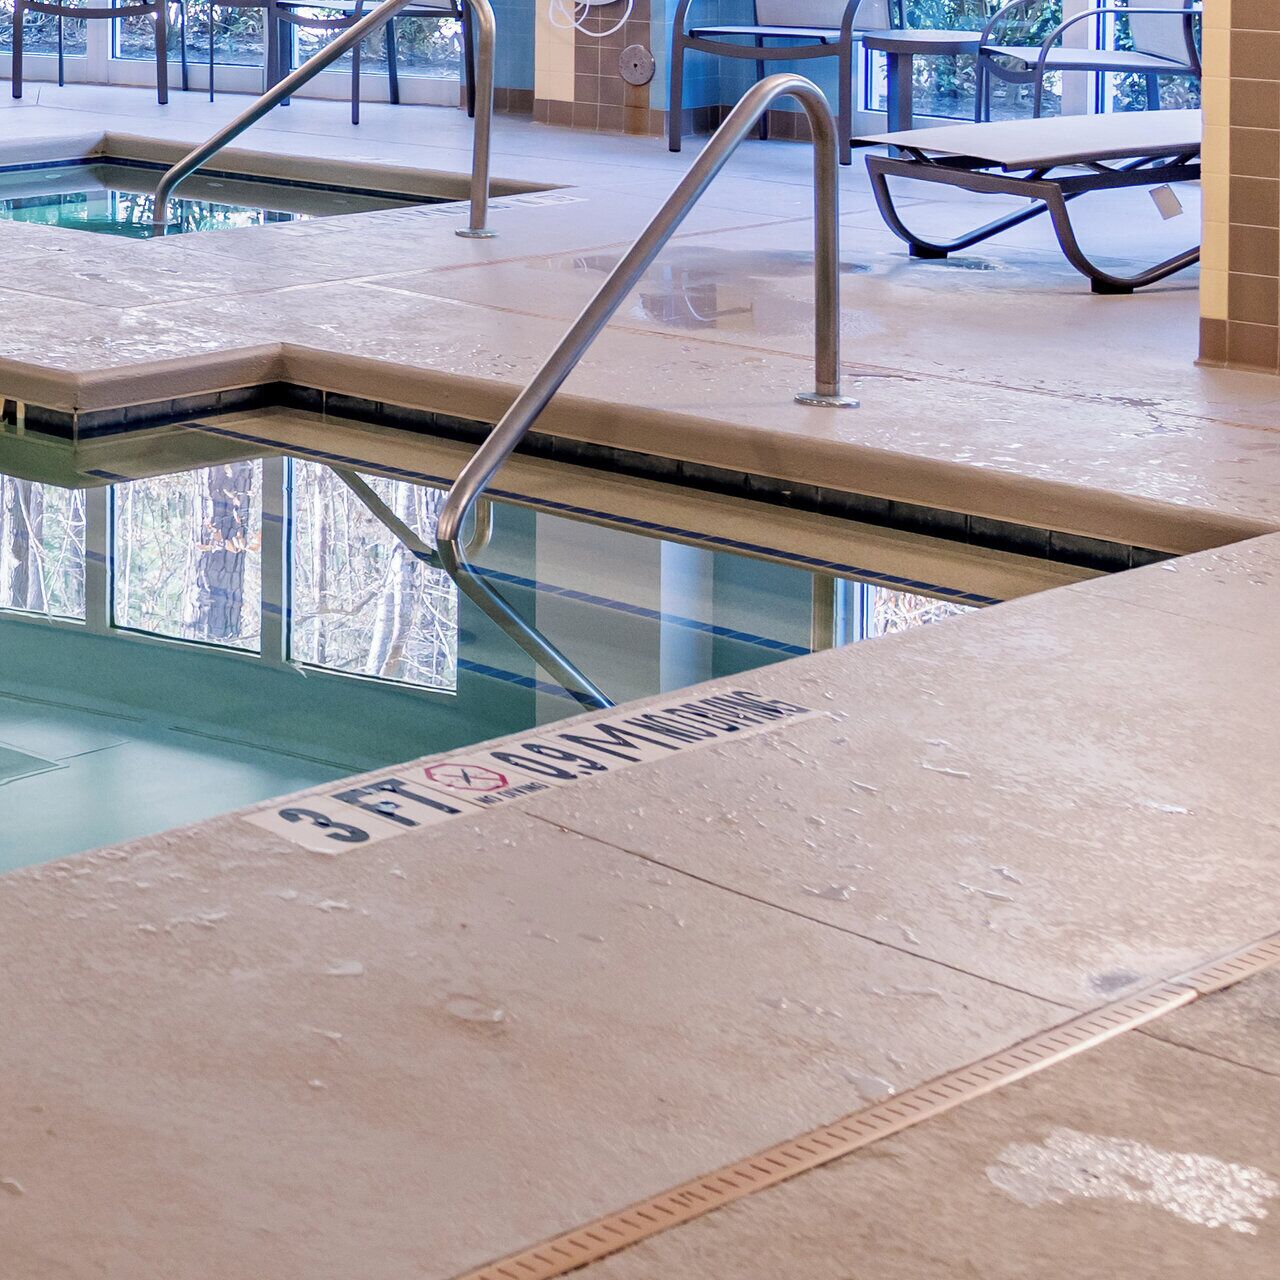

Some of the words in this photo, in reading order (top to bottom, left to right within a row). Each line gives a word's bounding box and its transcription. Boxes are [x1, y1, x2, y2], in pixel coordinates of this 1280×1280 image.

[622, 714, 718, 743] NO
[662, 691, 811, 732] DIVING
[558, 719, 682, 762] M
[490, 742, 609, 780] 0.9
[331, 778, 462, 826] FT
[278, 808, 370, 843] 3
